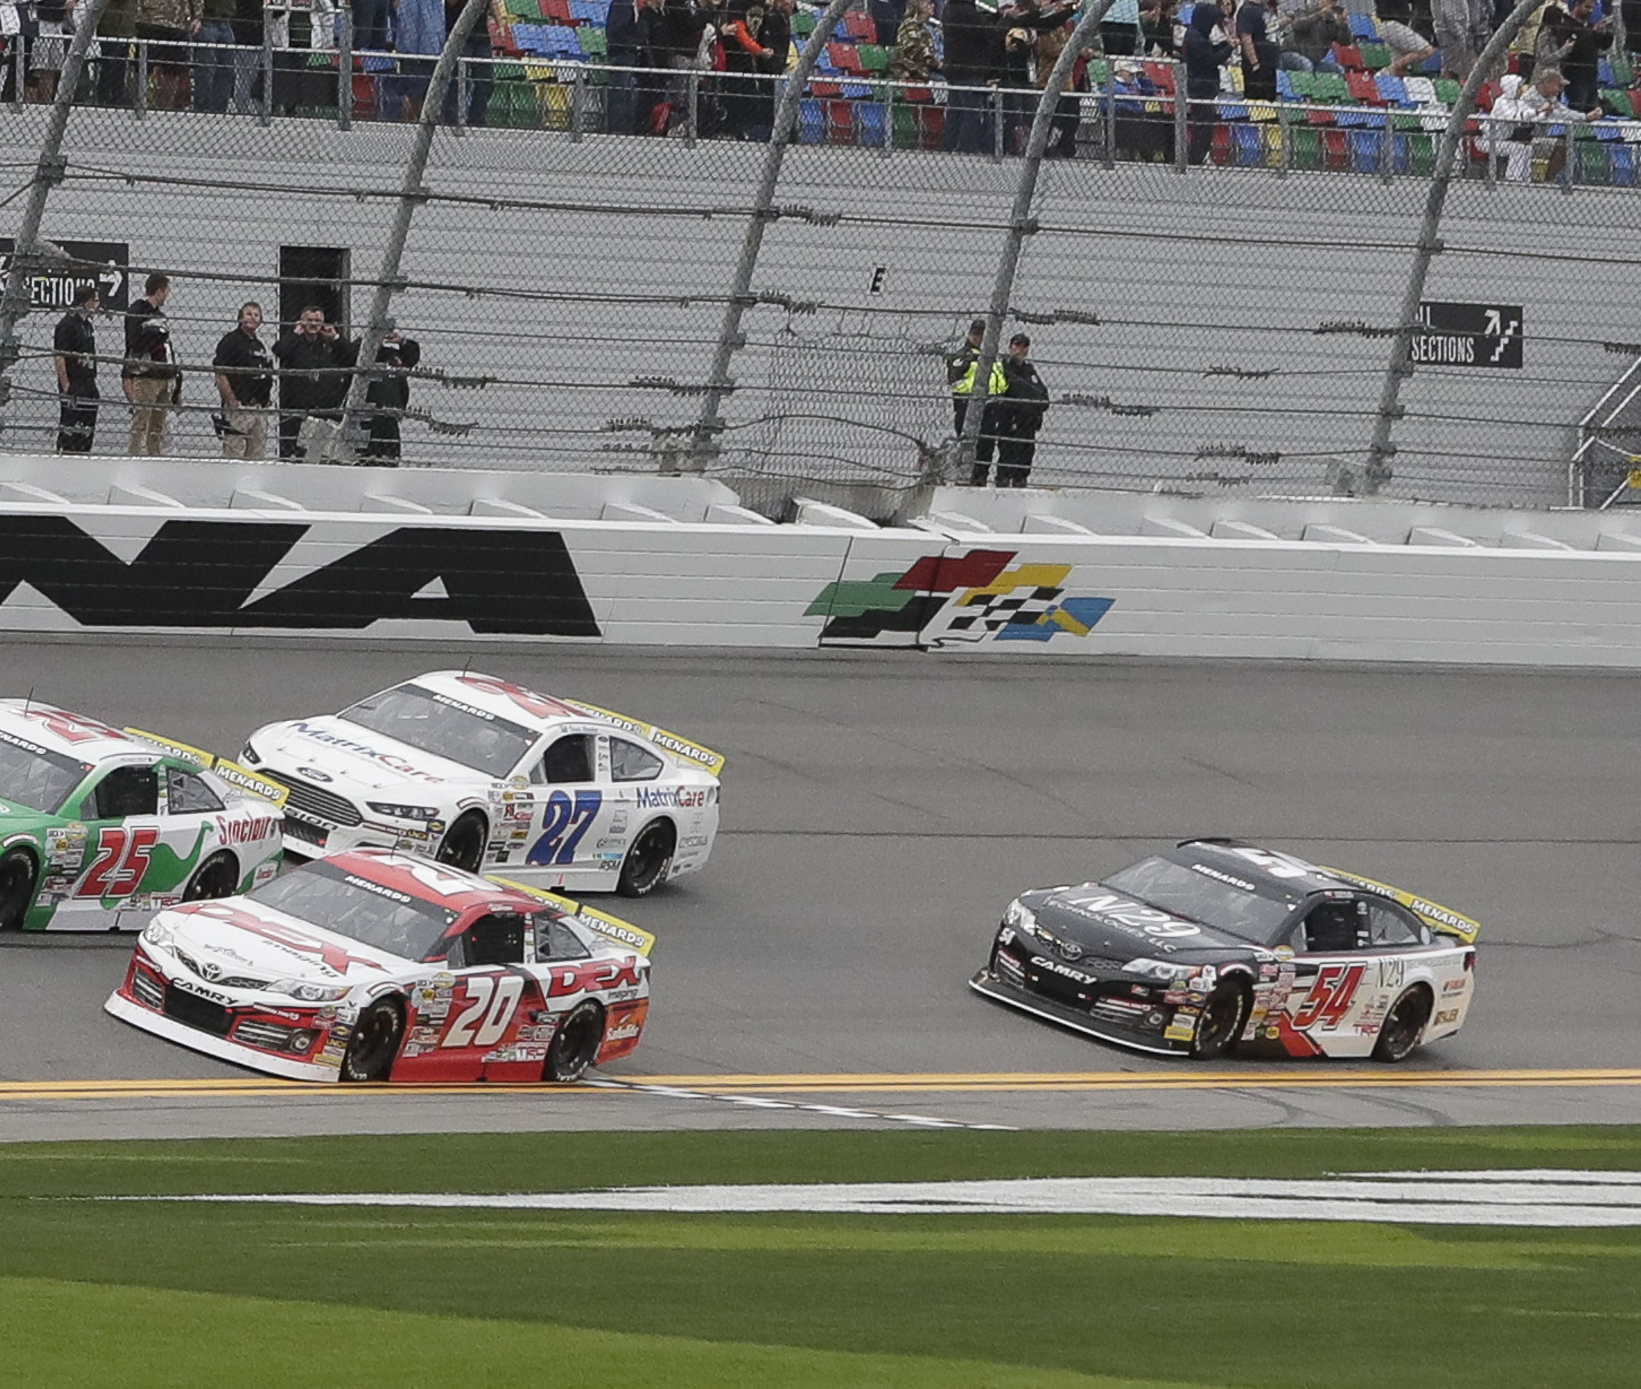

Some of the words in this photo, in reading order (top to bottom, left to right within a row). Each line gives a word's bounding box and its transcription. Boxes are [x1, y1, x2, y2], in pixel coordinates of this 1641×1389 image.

[870, 266, 886, 292] E
[1411, 335, 1475, 363] SECTIONS
[433, 694, 495, 721] MENARDS
[654, 733, 718, 766] MENARDS
[216, 765, 282, 800] MENARDS
[636, 786, 705, 809] MatrixCare
[216, 811, 273, 845] Sinclair
[526, 789, 602, 866] 27
[72, 825, 161, 900] 25
[1193, 864, 1256, 891] MENARDS
[345, 874, 412, 903] MENARDS
[578, 913, 645, 947] MENARDS
[1068, 895, 1201, 938] N29
[1411, 899, 1475, 934] MENARDS
[1148, 936, 1177, 953] LLC
[546, 955, 640, 998] DEX
[1030, 956, 1098, 985] CAMRY
[1375, 956, 1405, 988] N29
[169, 977, 239, 1006] CAMRY
[1290, 961, 1368, 1030] 54
[441, 975, 524, 1047] 20
